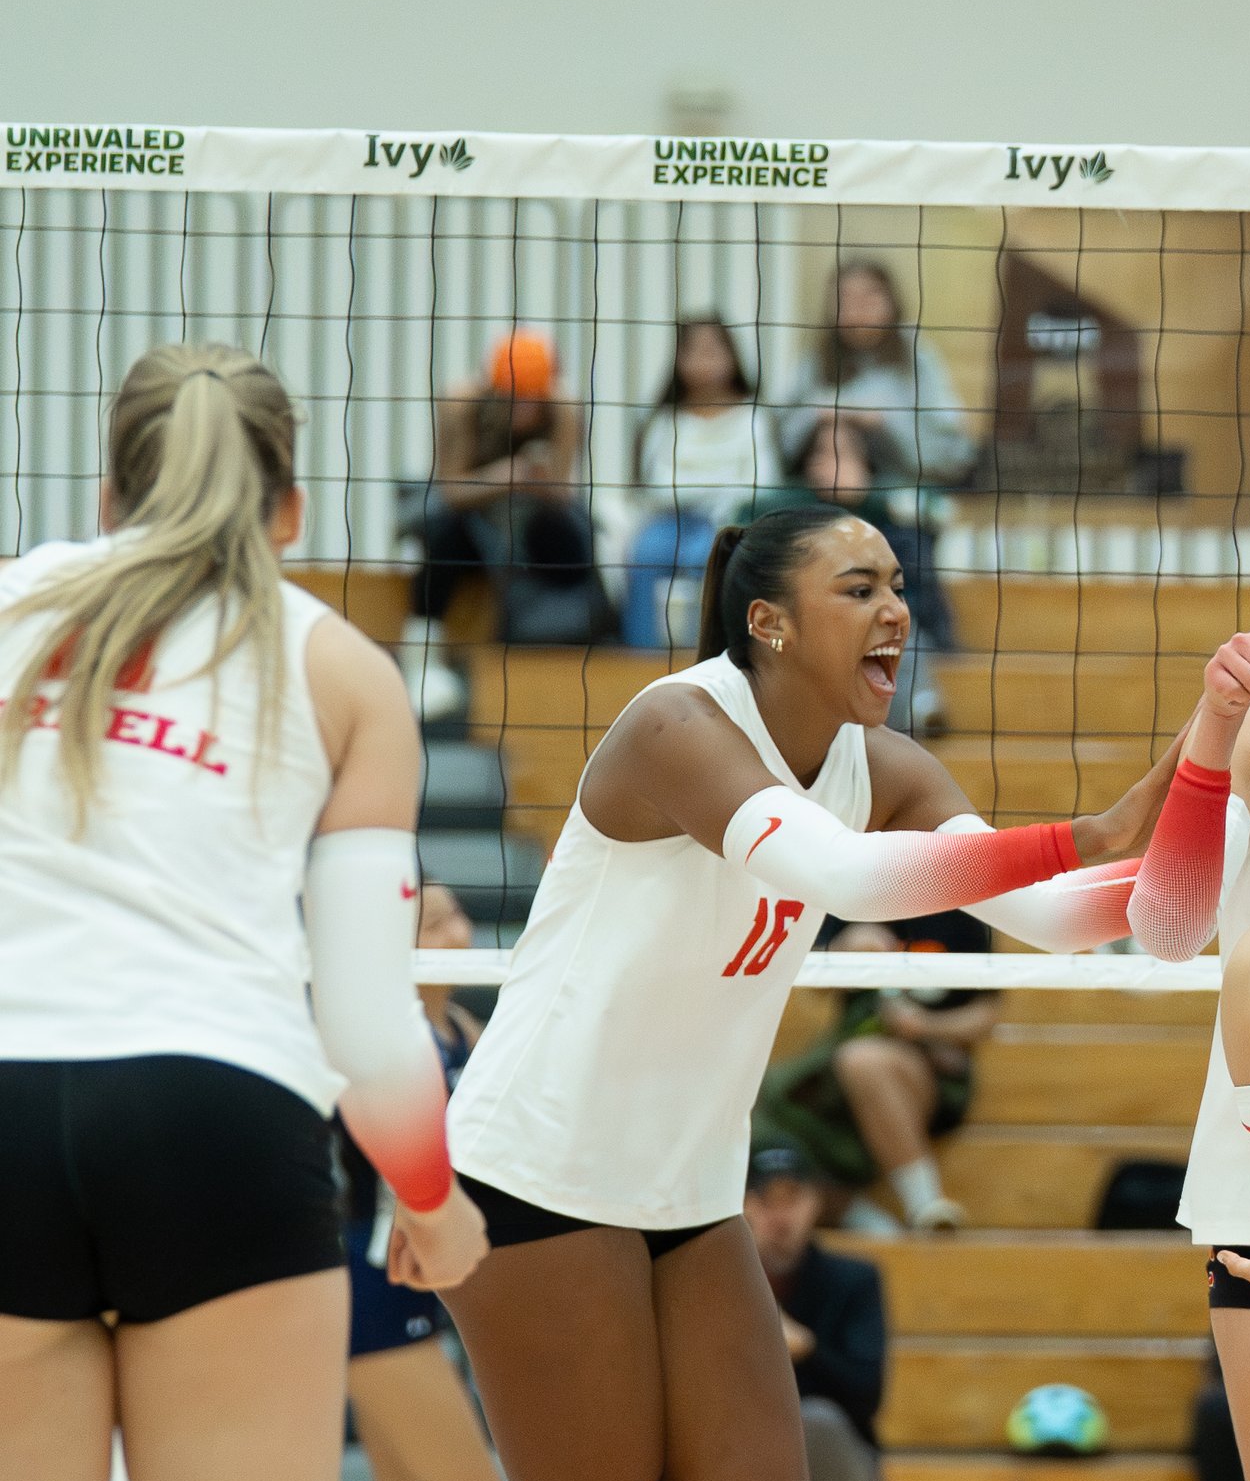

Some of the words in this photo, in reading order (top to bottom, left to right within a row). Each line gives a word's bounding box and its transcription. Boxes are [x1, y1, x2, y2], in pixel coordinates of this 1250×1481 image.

[6, 127, 185, 150] UNRIVALED
[6, 151, 185, 175] EXPERIENCE
[363, 134, 434, 178] Ivy
[654, 140, 829, 164] UNRIVALED
[653, 164, 828, 188] EXPERIENCE
[1005, 147, 1075, 191] Ivy
[721, 897, 805, 977] 16
